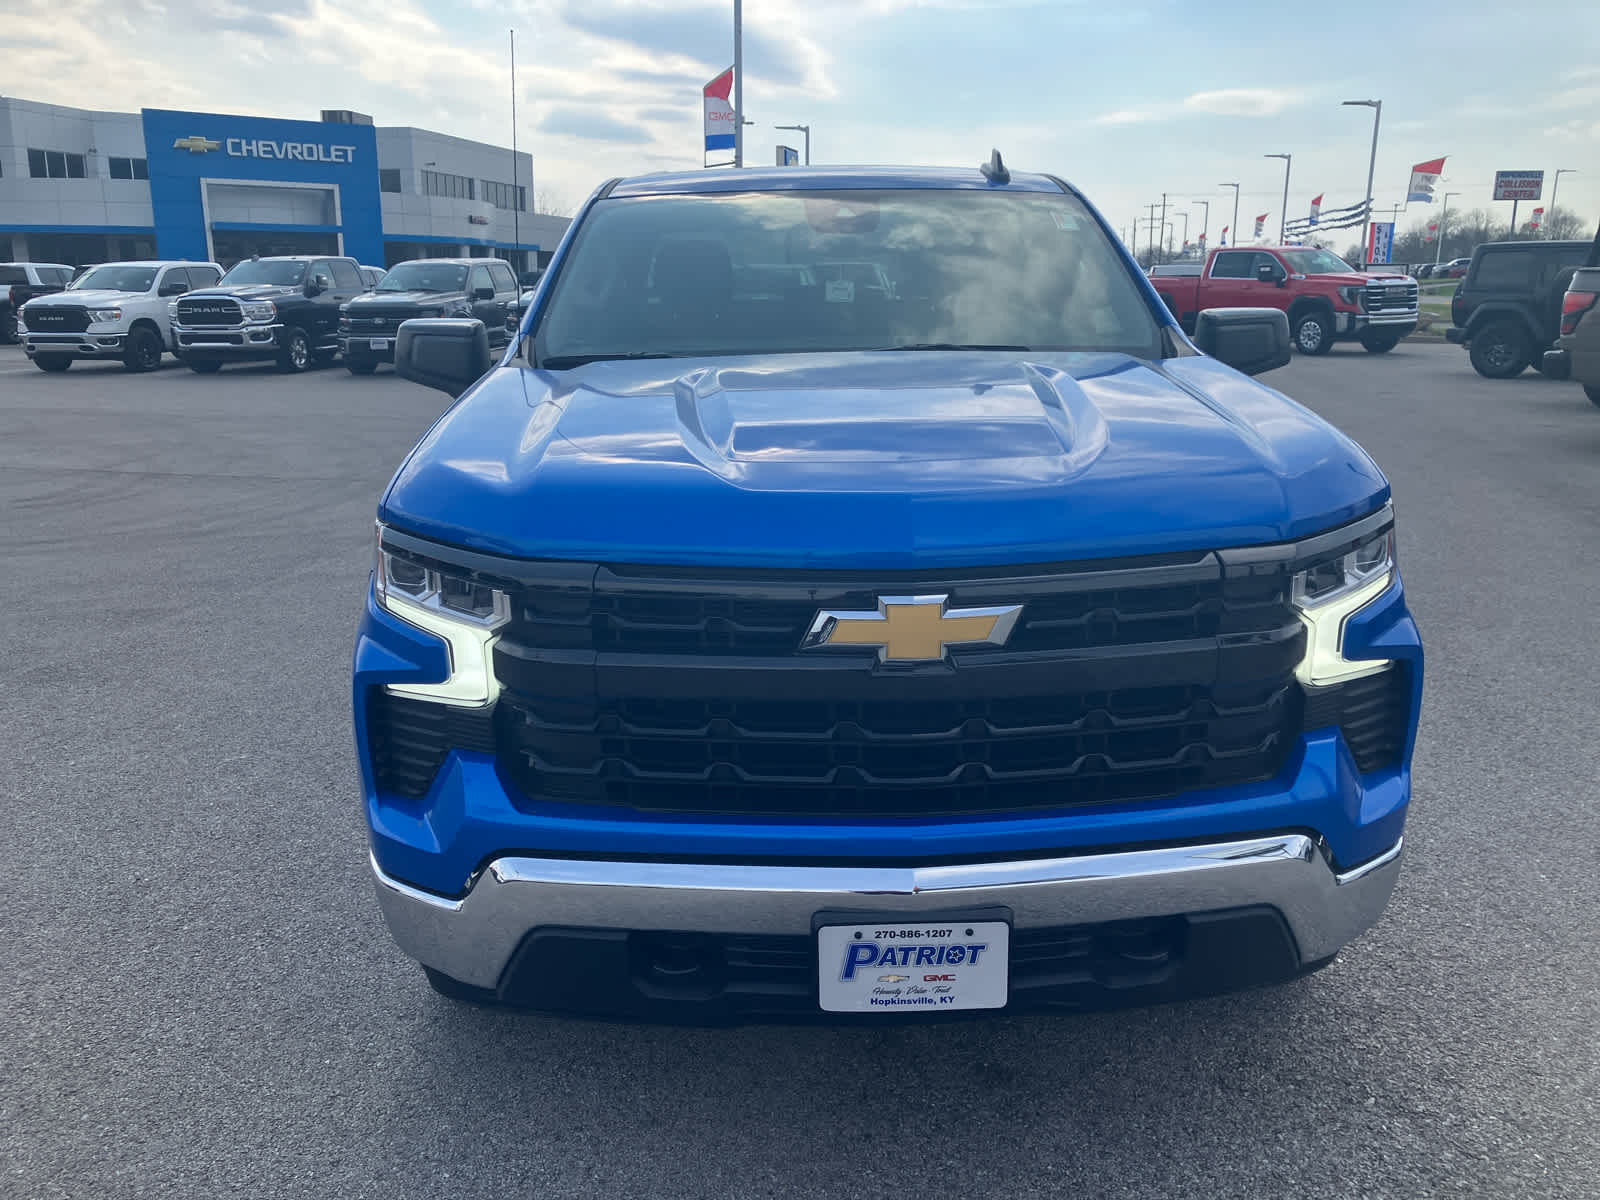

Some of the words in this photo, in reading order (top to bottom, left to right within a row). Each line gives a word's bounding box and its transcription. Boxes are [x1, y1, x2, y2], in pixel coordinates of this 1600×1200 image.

[226, 138, 356, 163] CHEVROLET
[874, 929, 953, 940] 270-886-1207
[839, 941, 988, 982] PATRIOT
[923, 974, 956, 982] GMC
[870, 997, 937, 1007] Hopkinsville,
[940, 996, 955, 1004] KY
